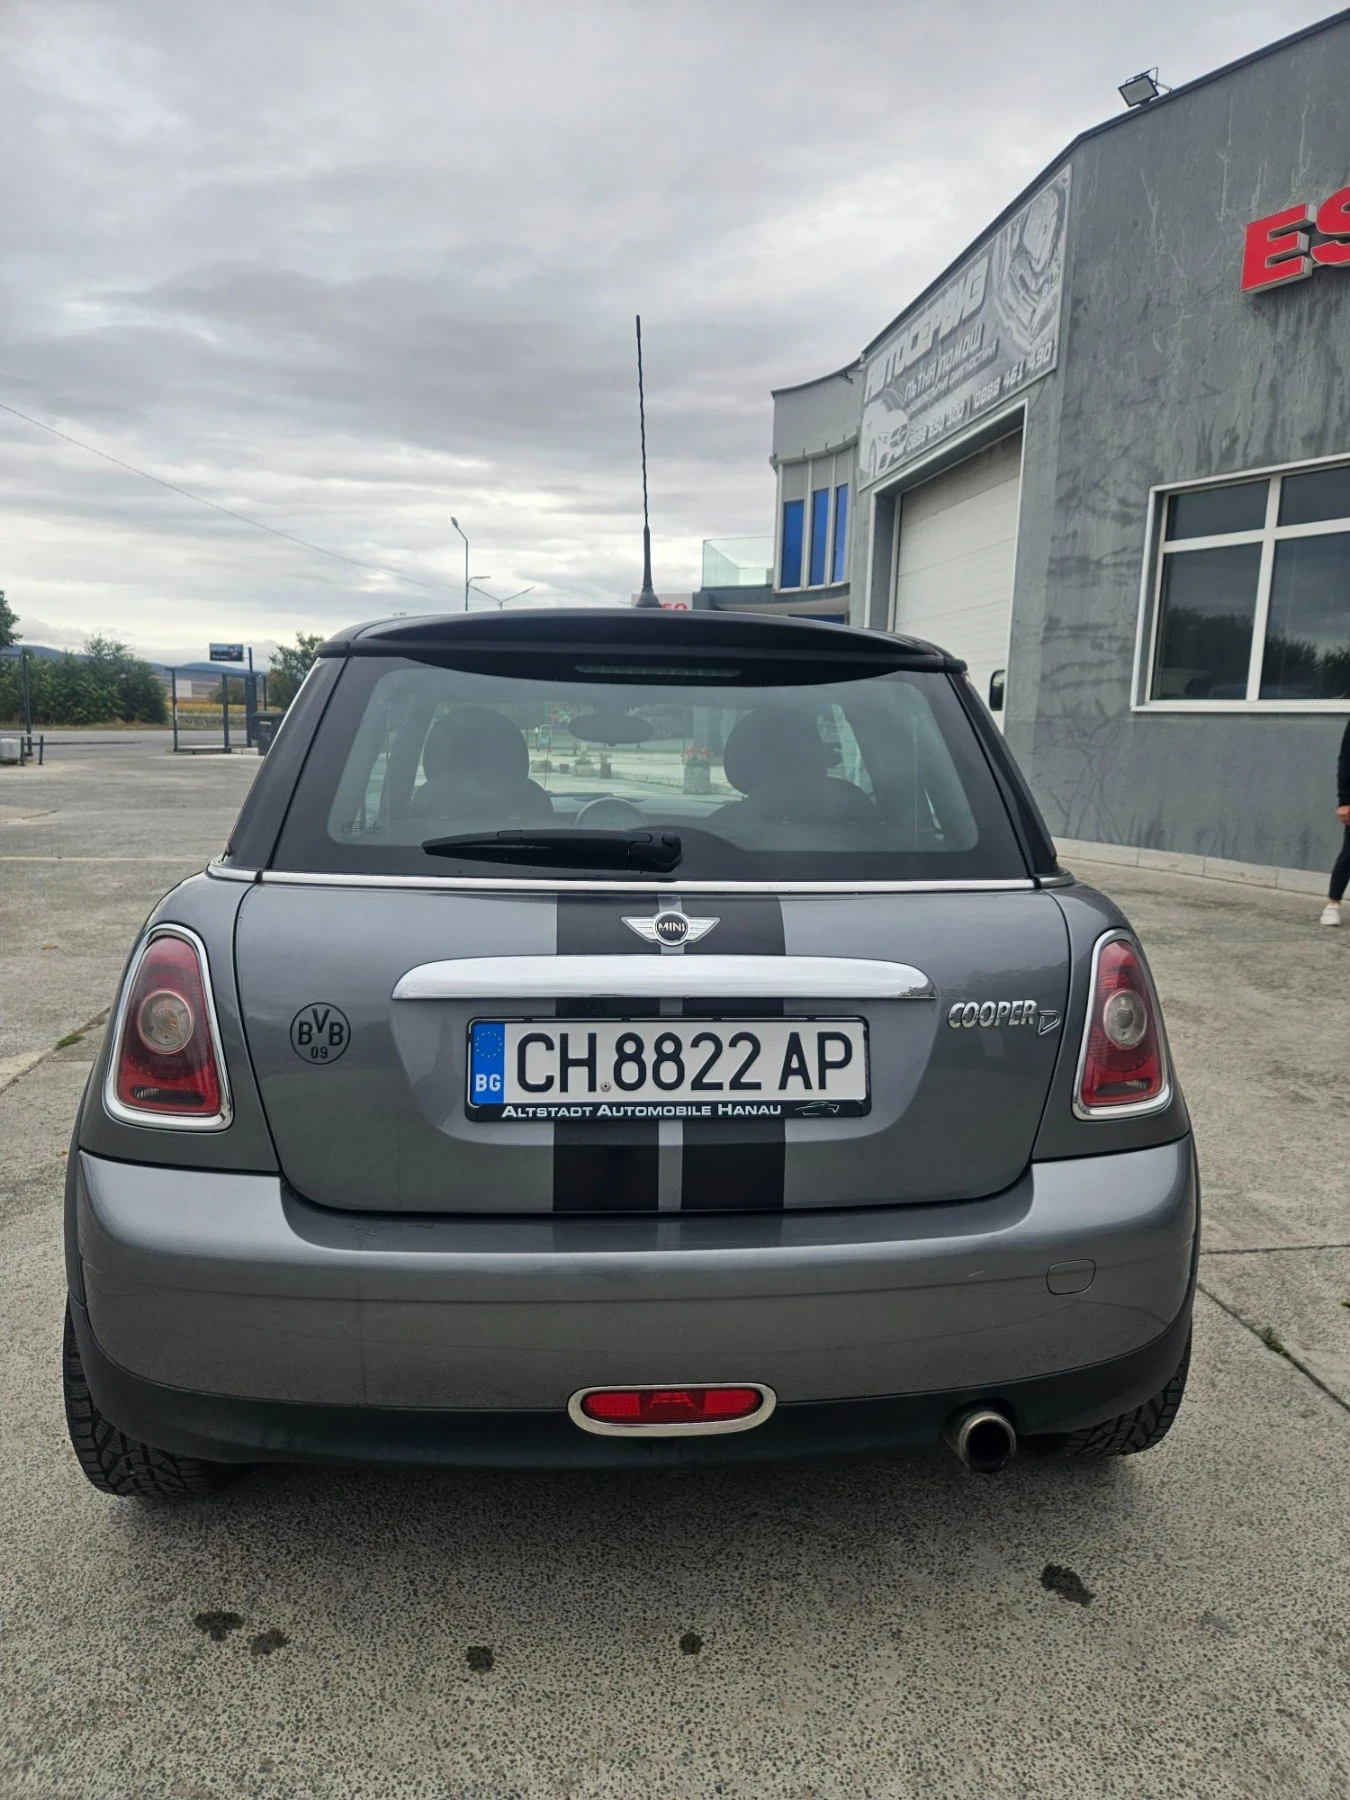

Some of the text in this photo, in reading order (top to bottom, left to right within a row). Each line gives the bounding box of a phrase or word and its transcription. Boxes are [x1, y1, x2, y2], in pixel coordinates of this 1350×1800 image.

[973, 375, 999, 410] 0888
[1003, 359, 1024, 391] 461
[1027, 339, 1052, 375] 490
[658, 922, 685, 931] MINI
[298, 1008, 344, 1046] BVB
[948, 1000, 1037, 1028] COOPER
[311, 1046, 328, 1059] 09
[517, 1031, 853, 1093] CH 8822 AP
[475, 1074, 501, 1092] BG
